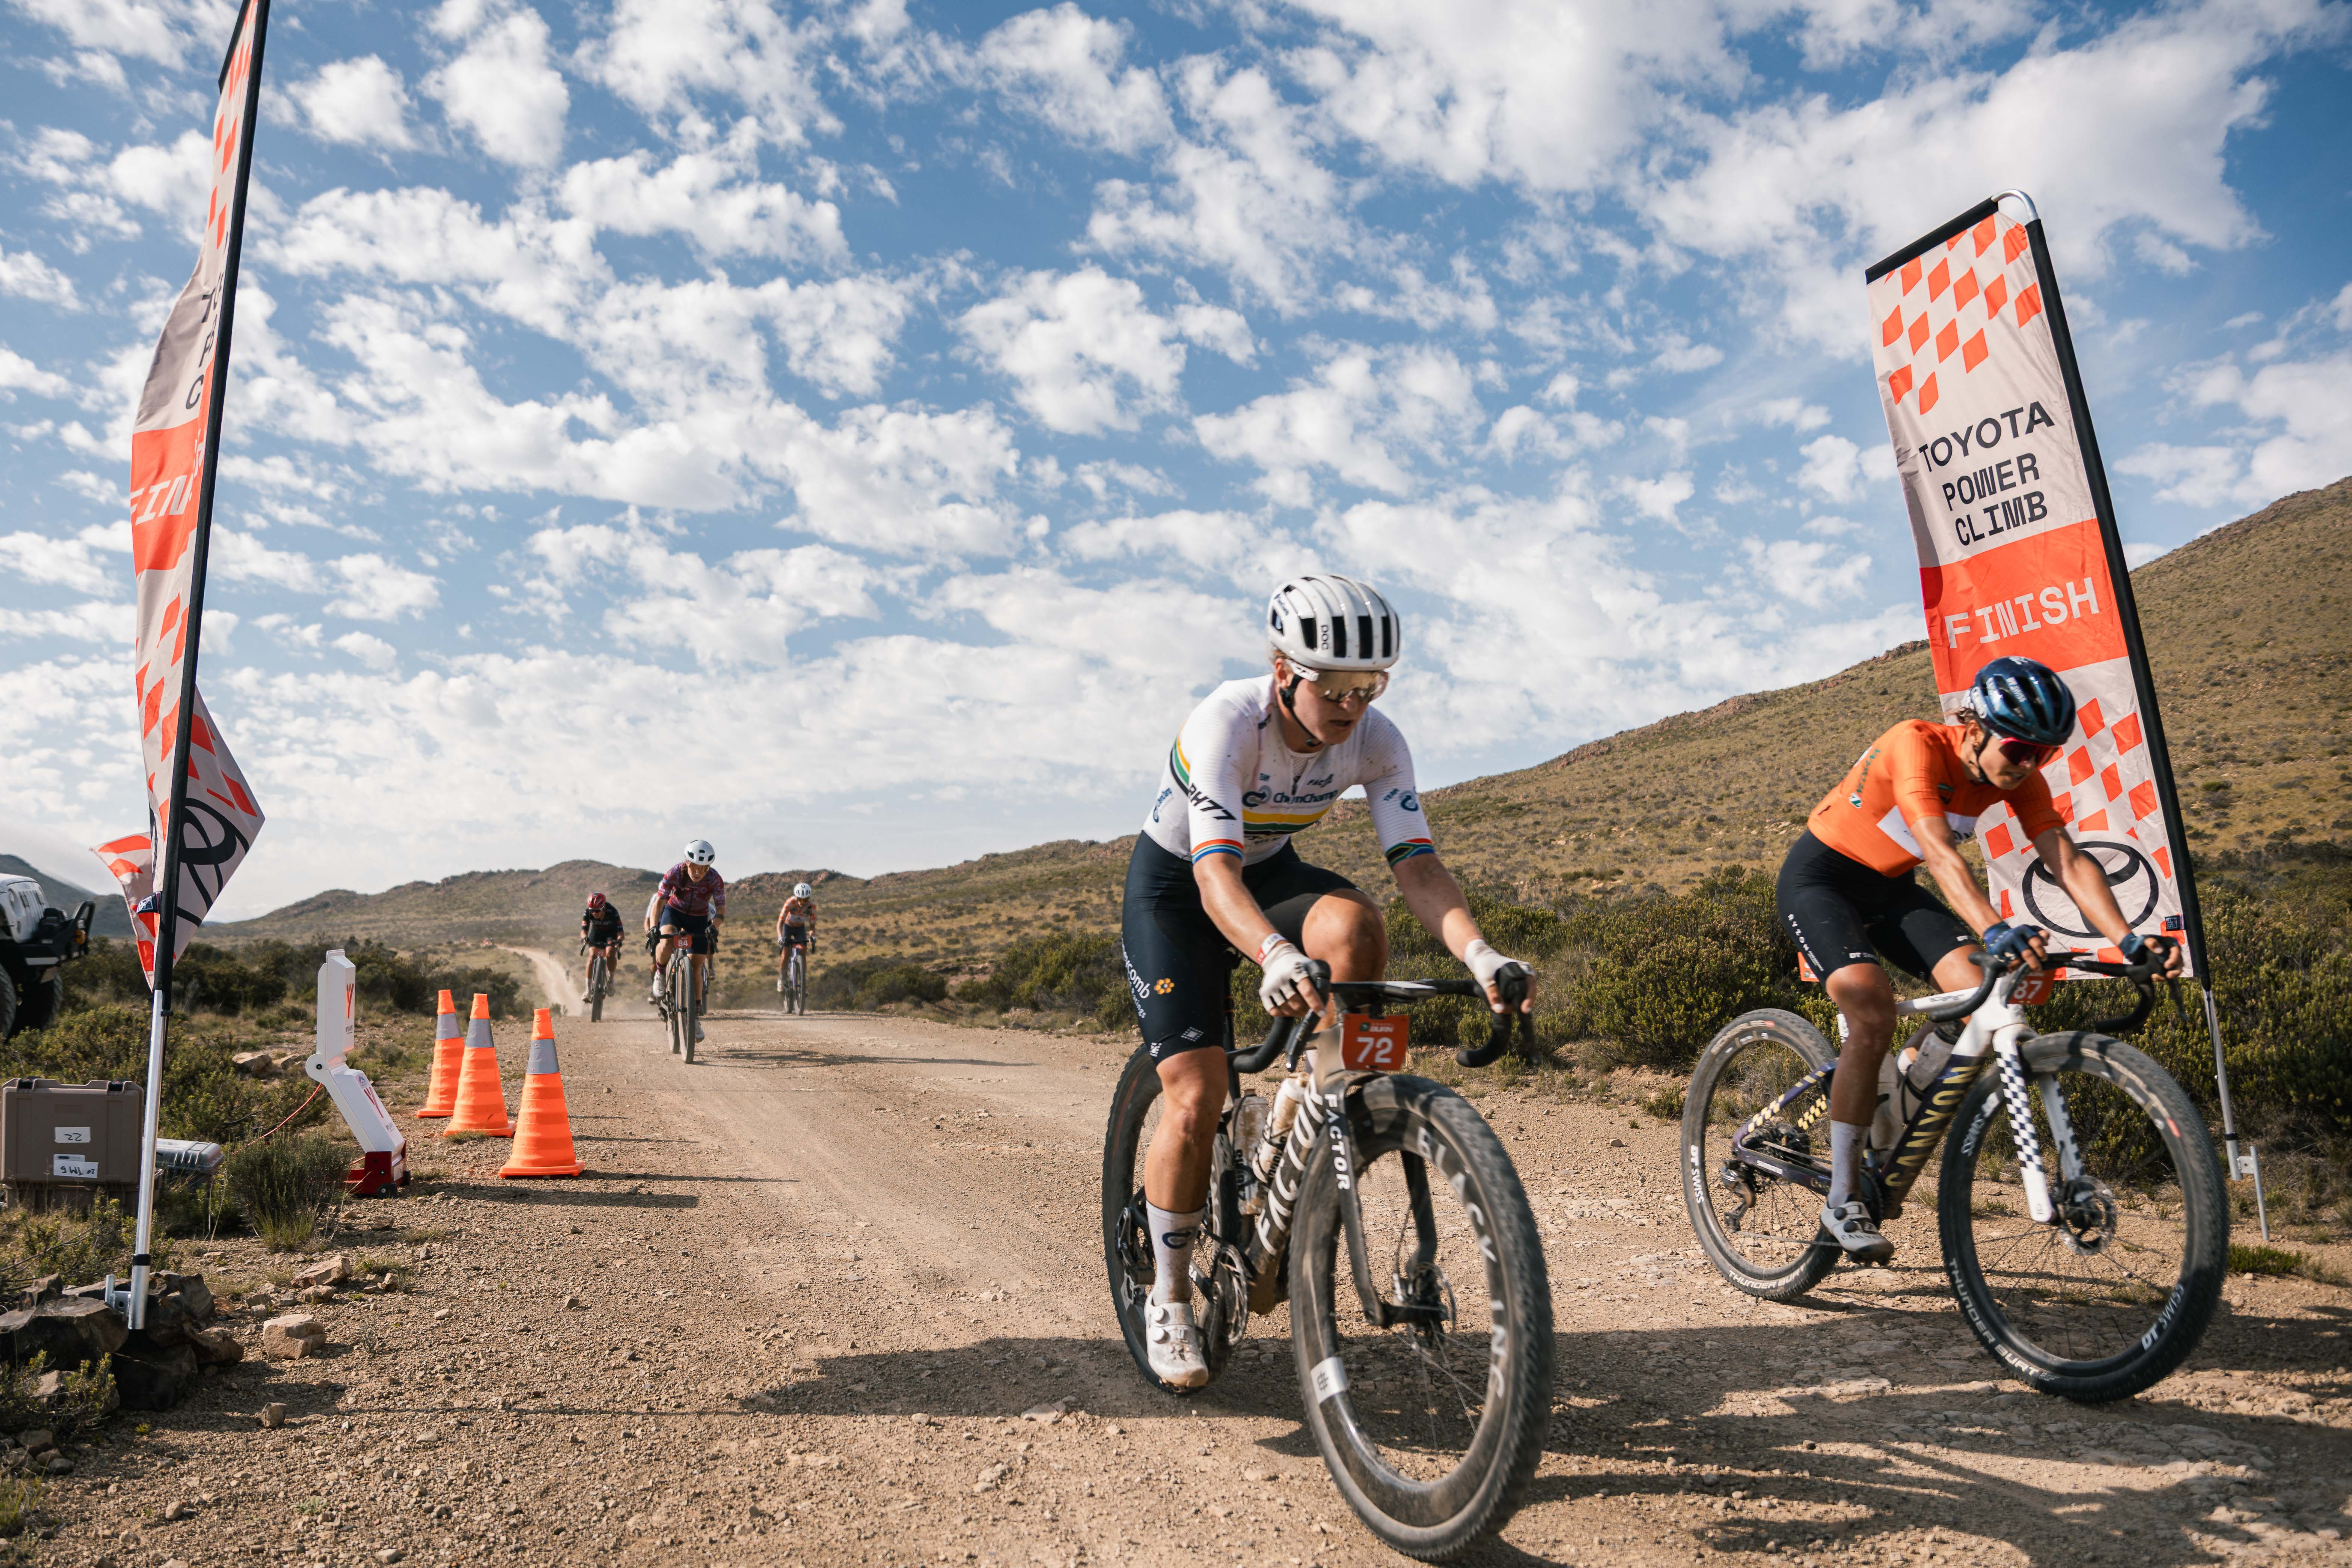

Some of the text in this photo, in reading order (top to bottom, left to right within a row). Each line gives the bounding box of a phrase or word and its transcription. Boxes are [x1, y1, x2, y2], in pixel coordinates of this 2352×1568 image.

[1919, 401, 2055, 473] TOYOTA
[1942, 452, 2040, 511] POWER
[1955, 490, 2048, 546] CLIMB
[1944, 577, 2100, 649] FINISH
[2014, 980, 2043, 999] 87
[1356, 1036, 1393, 1063] 72
[63, 1133, 82, 1142] 22
[1324, 1094, 1351, 1190] FACTOR
[1885, 1066, 1981, 1187] CANYON
[1690, 1144, 1705, 1204] DT SWISS
[1728, 1270, 1776, 1289] THUNDER
[1949, 1257, 2040, 1376] THUNDER BURT
